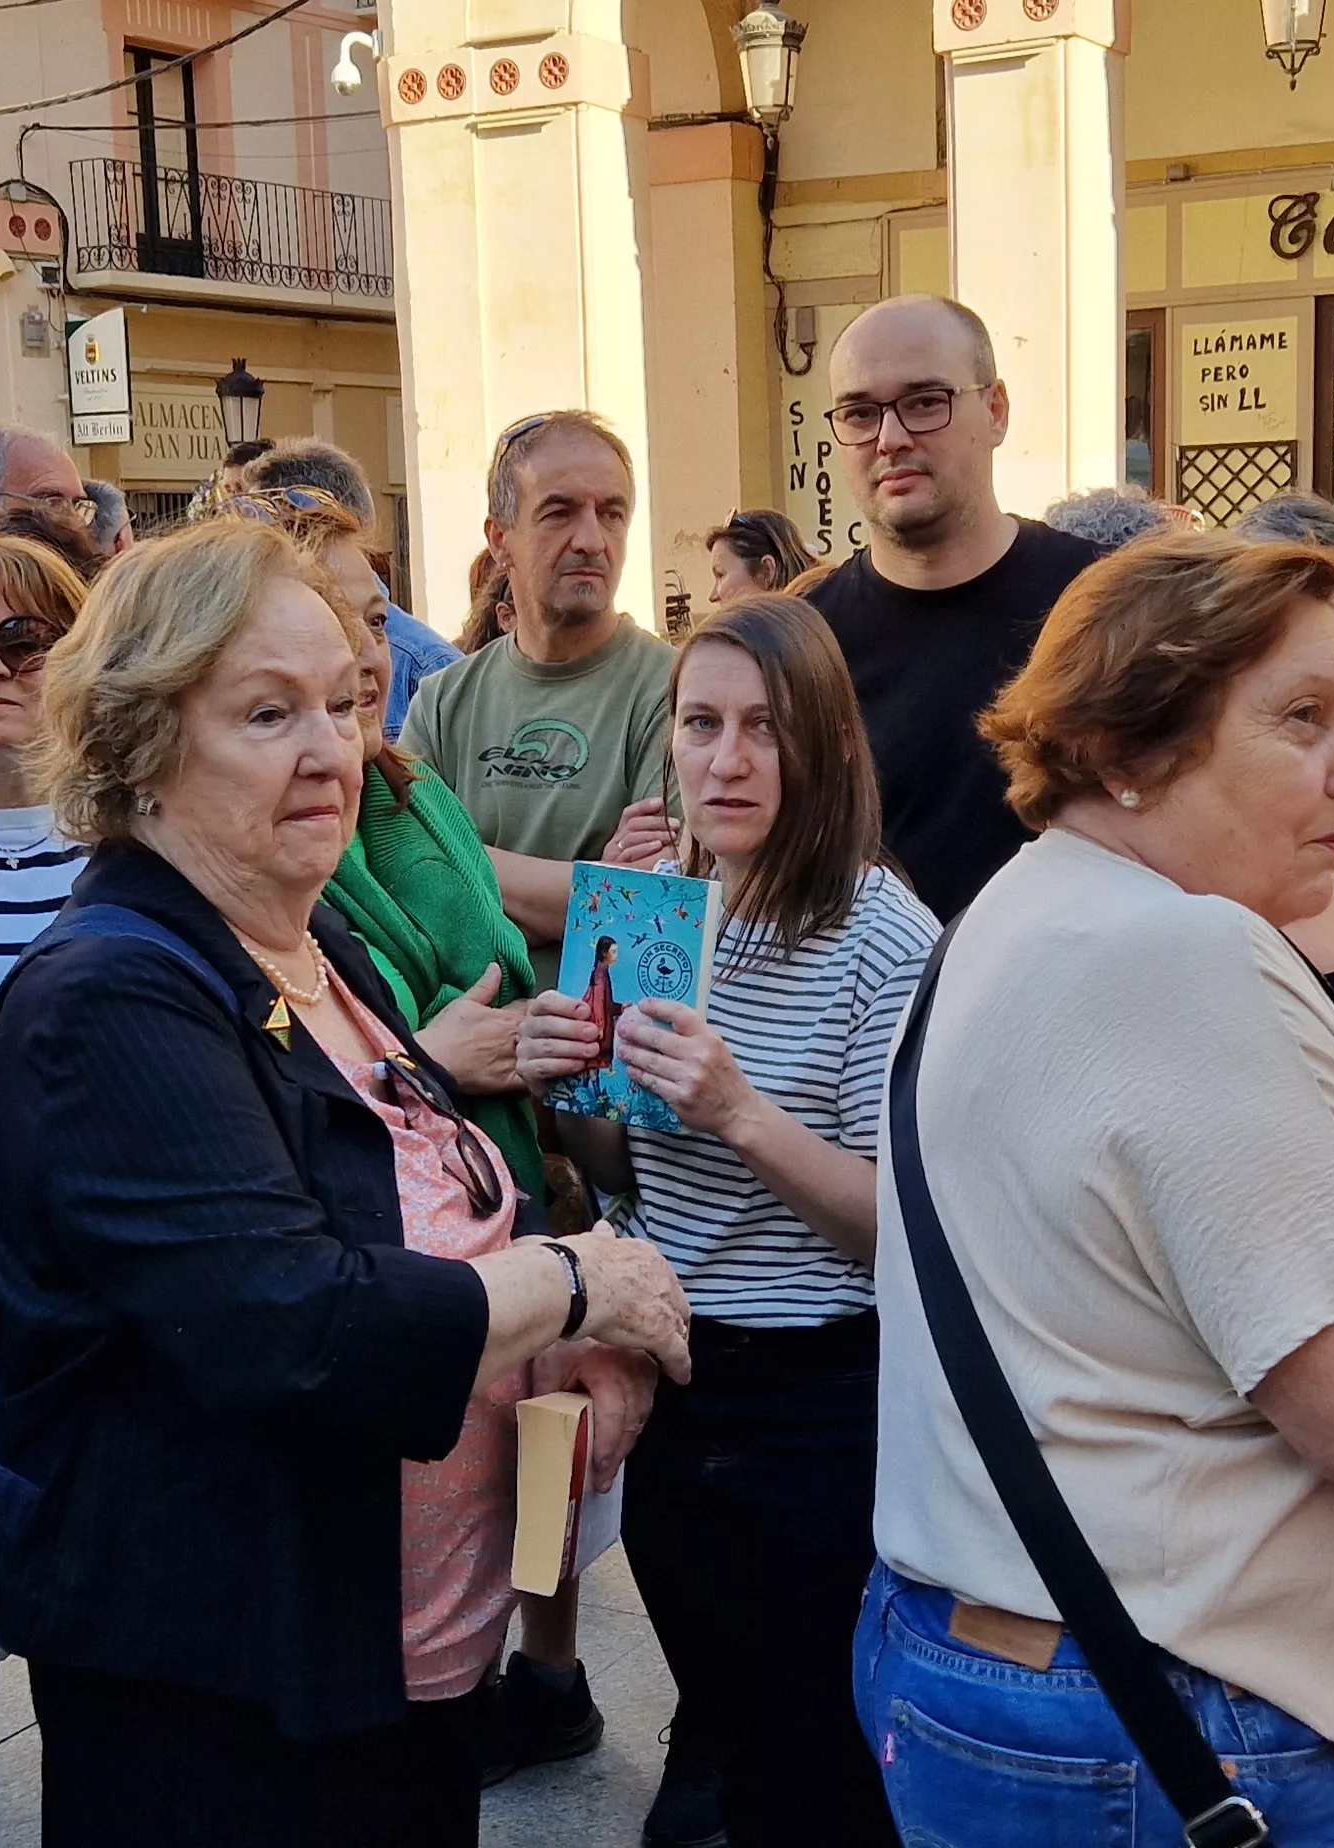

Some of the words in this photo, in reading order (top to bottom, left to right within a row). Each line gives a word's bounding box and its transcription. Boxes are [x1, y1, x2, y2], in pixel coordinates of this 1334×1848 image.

[1192, 329, 1289, 356] LLÁMAME
[74, 368, 117, 385] VELTINS
[1201, 364, 1249, 383] PERO
[1199, 392, 1229, 413] SIN
[1238, 387, 1267, 411] LL
[134, 401, 224, 430] ALMACEN
[144, 432, 180, 459] SAN
[187, 434, 223, 460] JUA
[789, 400, 807, 491] SIN
[816, 441, 832, 556] POES
[478, 746, 529, 762] EL
[642, 950, 654, 965] UN
[653, 943, 690, 970] SECRETO
